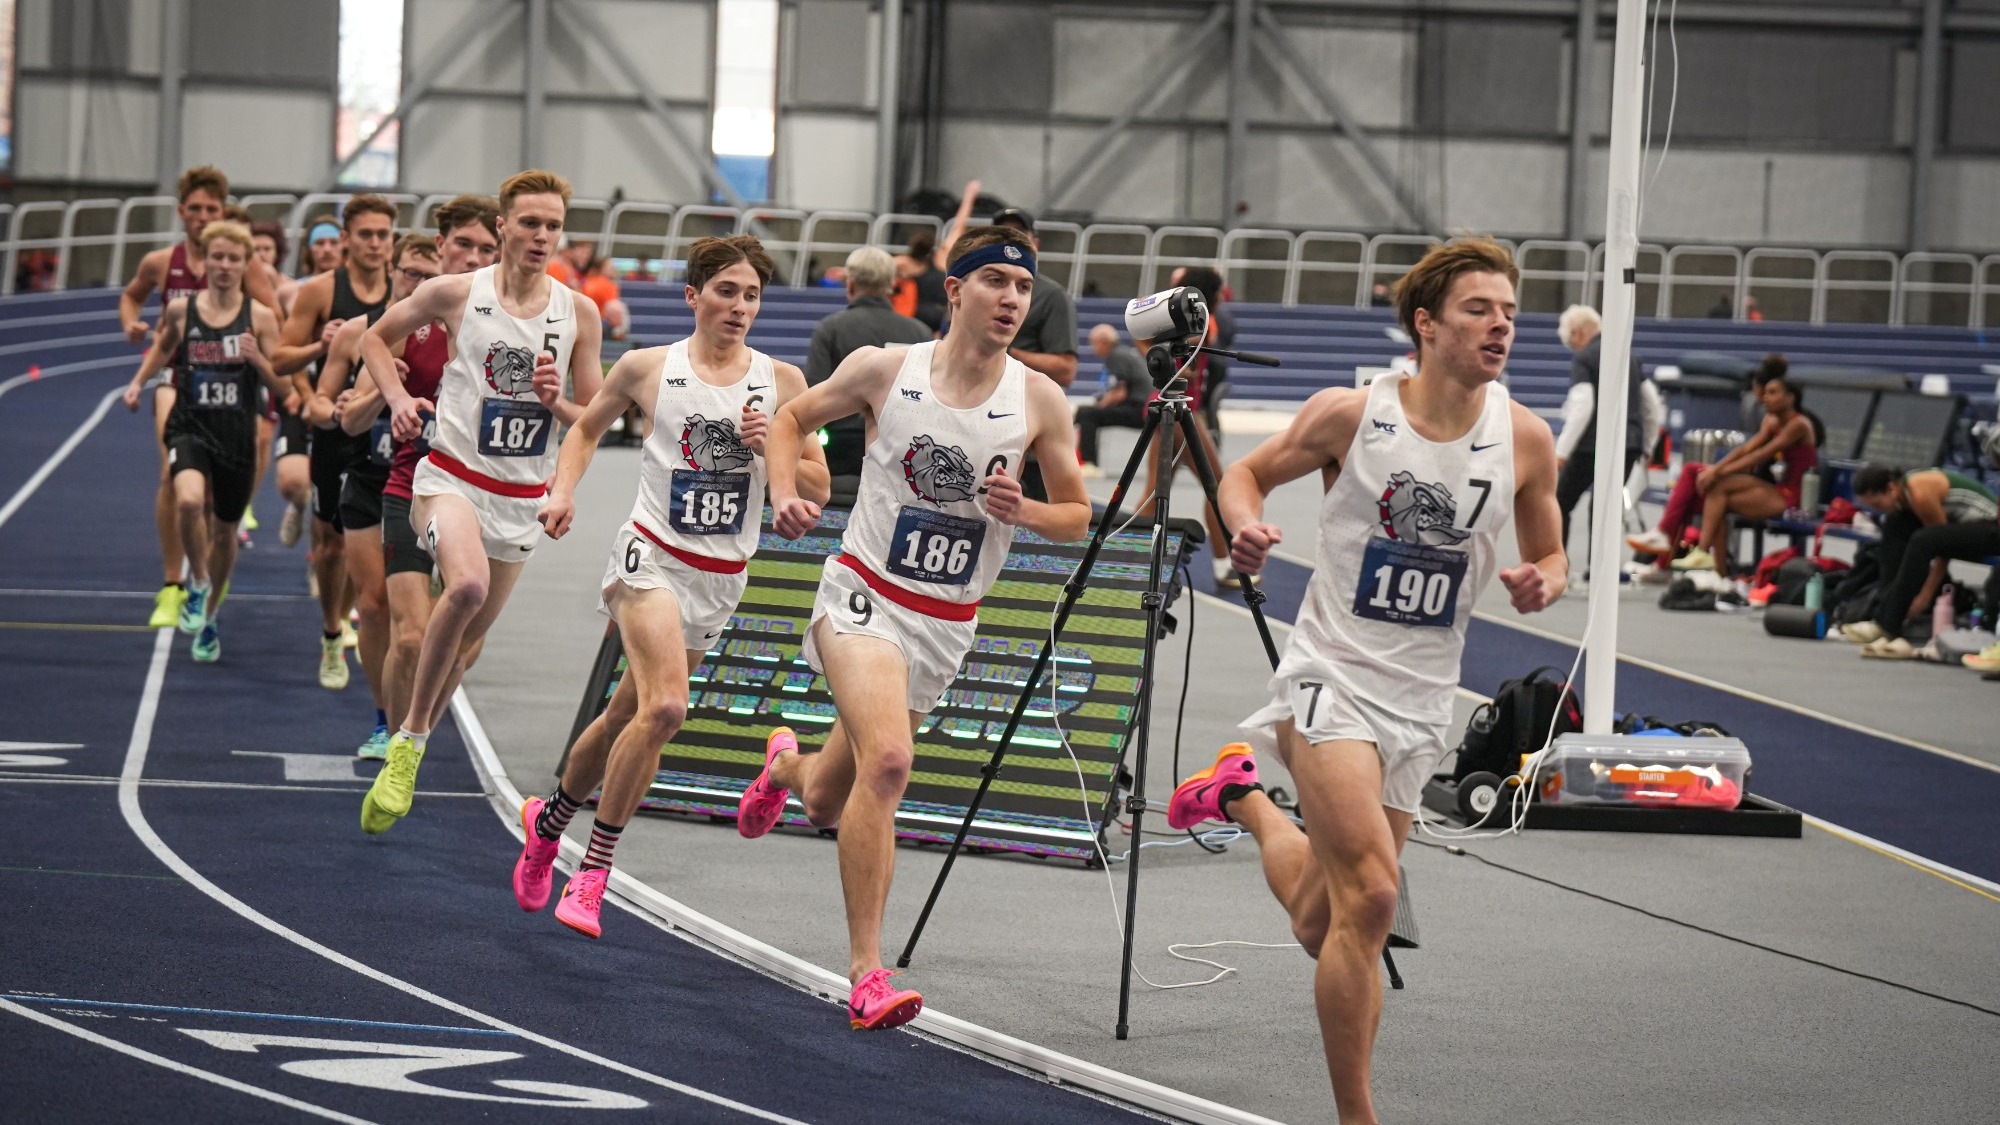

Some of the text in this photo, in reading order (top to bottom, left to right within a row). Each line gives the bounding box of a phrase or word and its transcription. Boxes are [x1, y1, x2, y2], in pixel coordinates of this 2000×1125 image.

[474, 306, 493, 315] WCC
[198, 382, 239, 405] 138
[666, 378, 687, 387] WCC
[901, 388, 923, 401] WCC
[489, 416, 544, 449] 187
[1372, 418, 1397, 434] WCC
[681, 490, 739, 526] 185
[1465, 478, 1493, 529] 7
[625, 536, 646, 574] 6
[900, 530, 972, 575] 186
[1369, 564, 1451, 616] 190
[848, 591, 873, 627] 9
[1299, 681, 1323, 729] 7
[1638, 772, 1665, 782] STARTER
